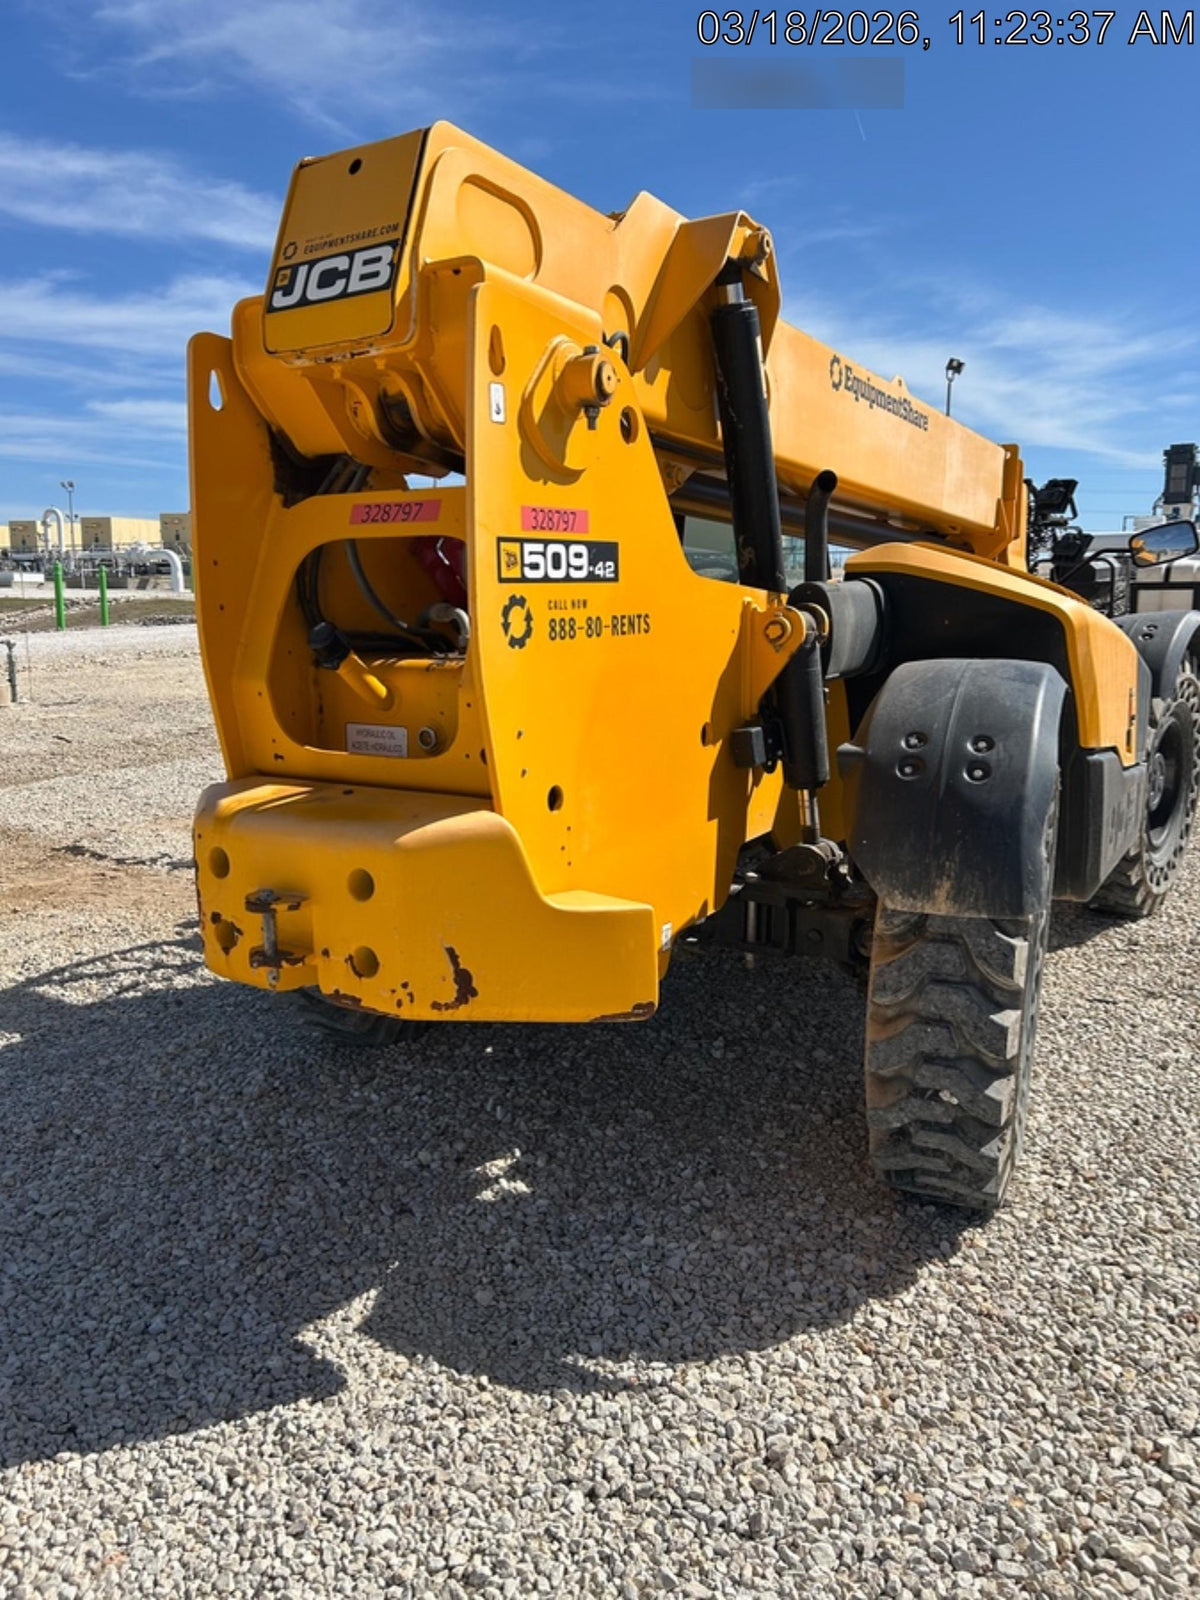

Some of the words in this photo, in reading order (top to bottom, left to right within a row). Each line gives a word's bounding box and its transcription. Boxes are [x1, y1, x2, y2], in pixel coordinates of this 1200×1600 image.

[271, 245, 394, 308] JCB
[844, 364, 928, 432] EquipmentShare
[361, 502, 424, 524] 328797
[530, 508, 577, 532] 328797
[548, 599, 568, 611] CALL
[571, 598, 588, 610] NOW
[549, 613, 651, 642] 888-80-RENTS
